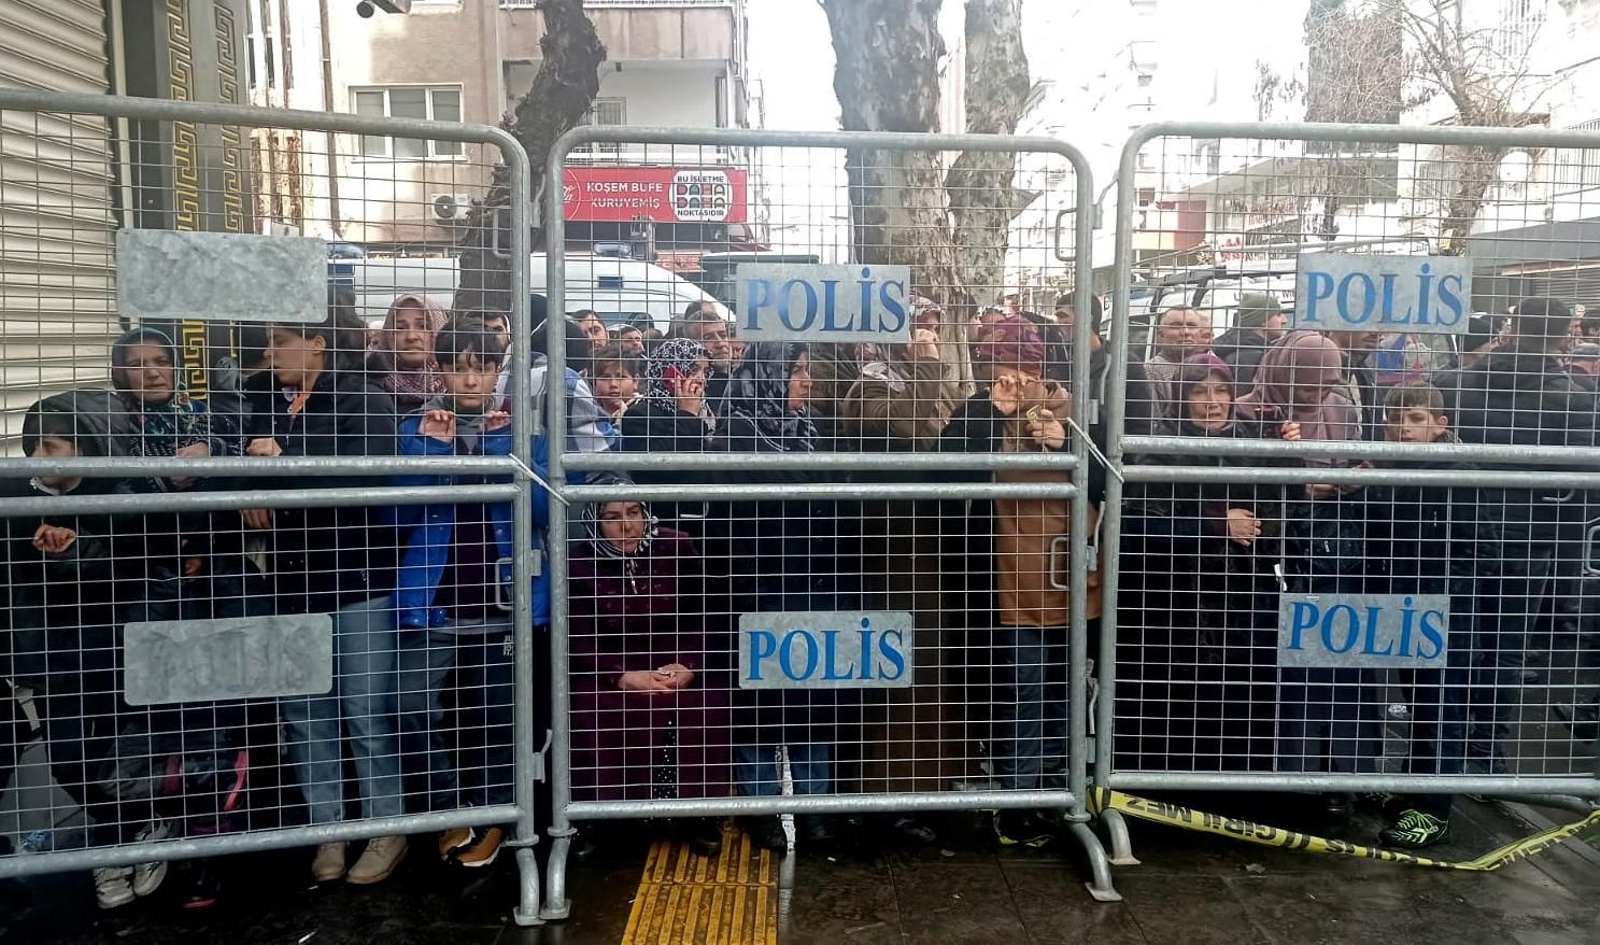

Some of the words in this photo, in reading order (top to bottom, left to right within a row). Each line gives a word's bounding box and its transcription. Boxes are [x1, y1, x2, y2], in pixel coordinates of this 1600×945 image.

[591, 196, 661, 209] KURUYEMİŞ
[677, 175, 689, 183] BU
[677, 209, 725, 217] NOKTASIDIR
[743, 266, 906, 333] POLİS
[1302, 262, 1464, 327] POLİS
[745, 617, 905, 681] POLİS
[1286, 596, 1445, 660] POLİS
